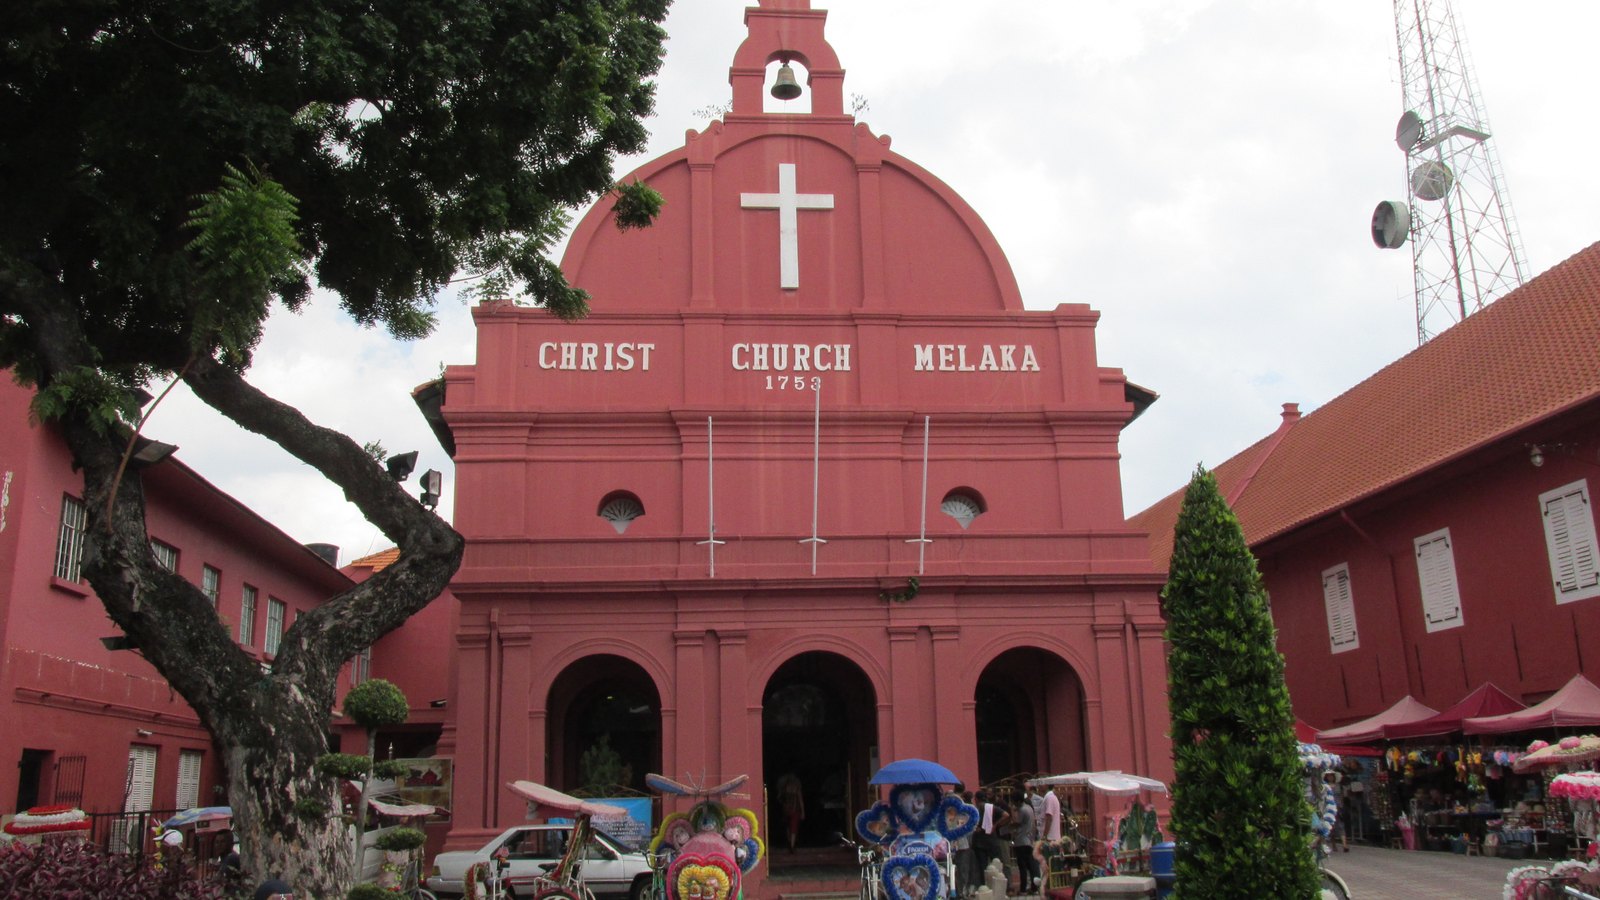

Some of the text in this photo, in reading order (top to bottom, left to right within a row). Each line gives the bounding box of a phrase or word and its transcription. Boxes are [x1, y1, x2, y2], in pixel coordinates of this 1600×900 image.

[538, 341, 1041, 372] CHRIST CHURCH MELAKA
[765, 375, 821, 391] 1753
